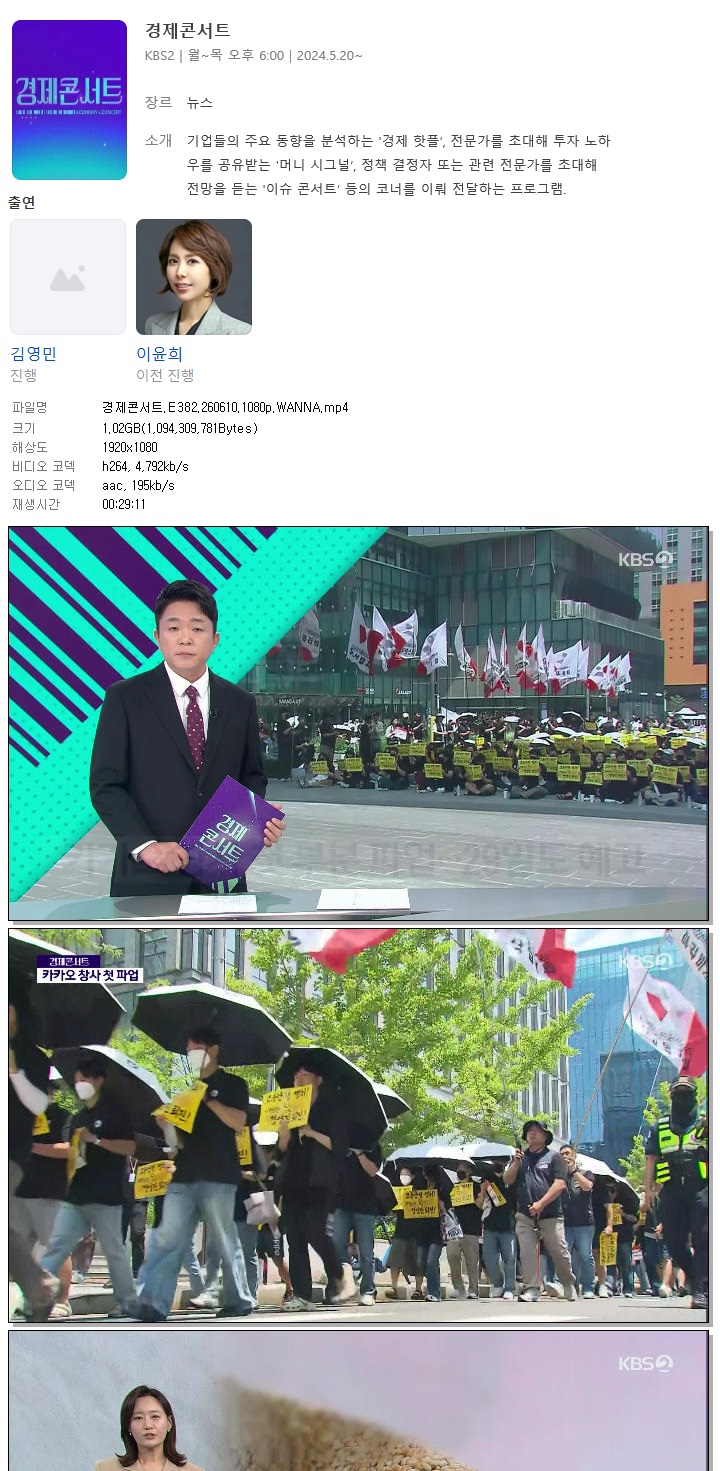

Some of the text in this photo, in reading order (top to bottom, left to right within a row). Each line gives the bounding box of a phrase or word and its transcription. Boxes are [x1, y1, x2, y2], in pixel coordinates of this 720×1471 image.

[16, 77, 123, 106] 경제콘서트
[216, 814, 248, 842] 경제
[199, 828, 245, 864] 콘서트
